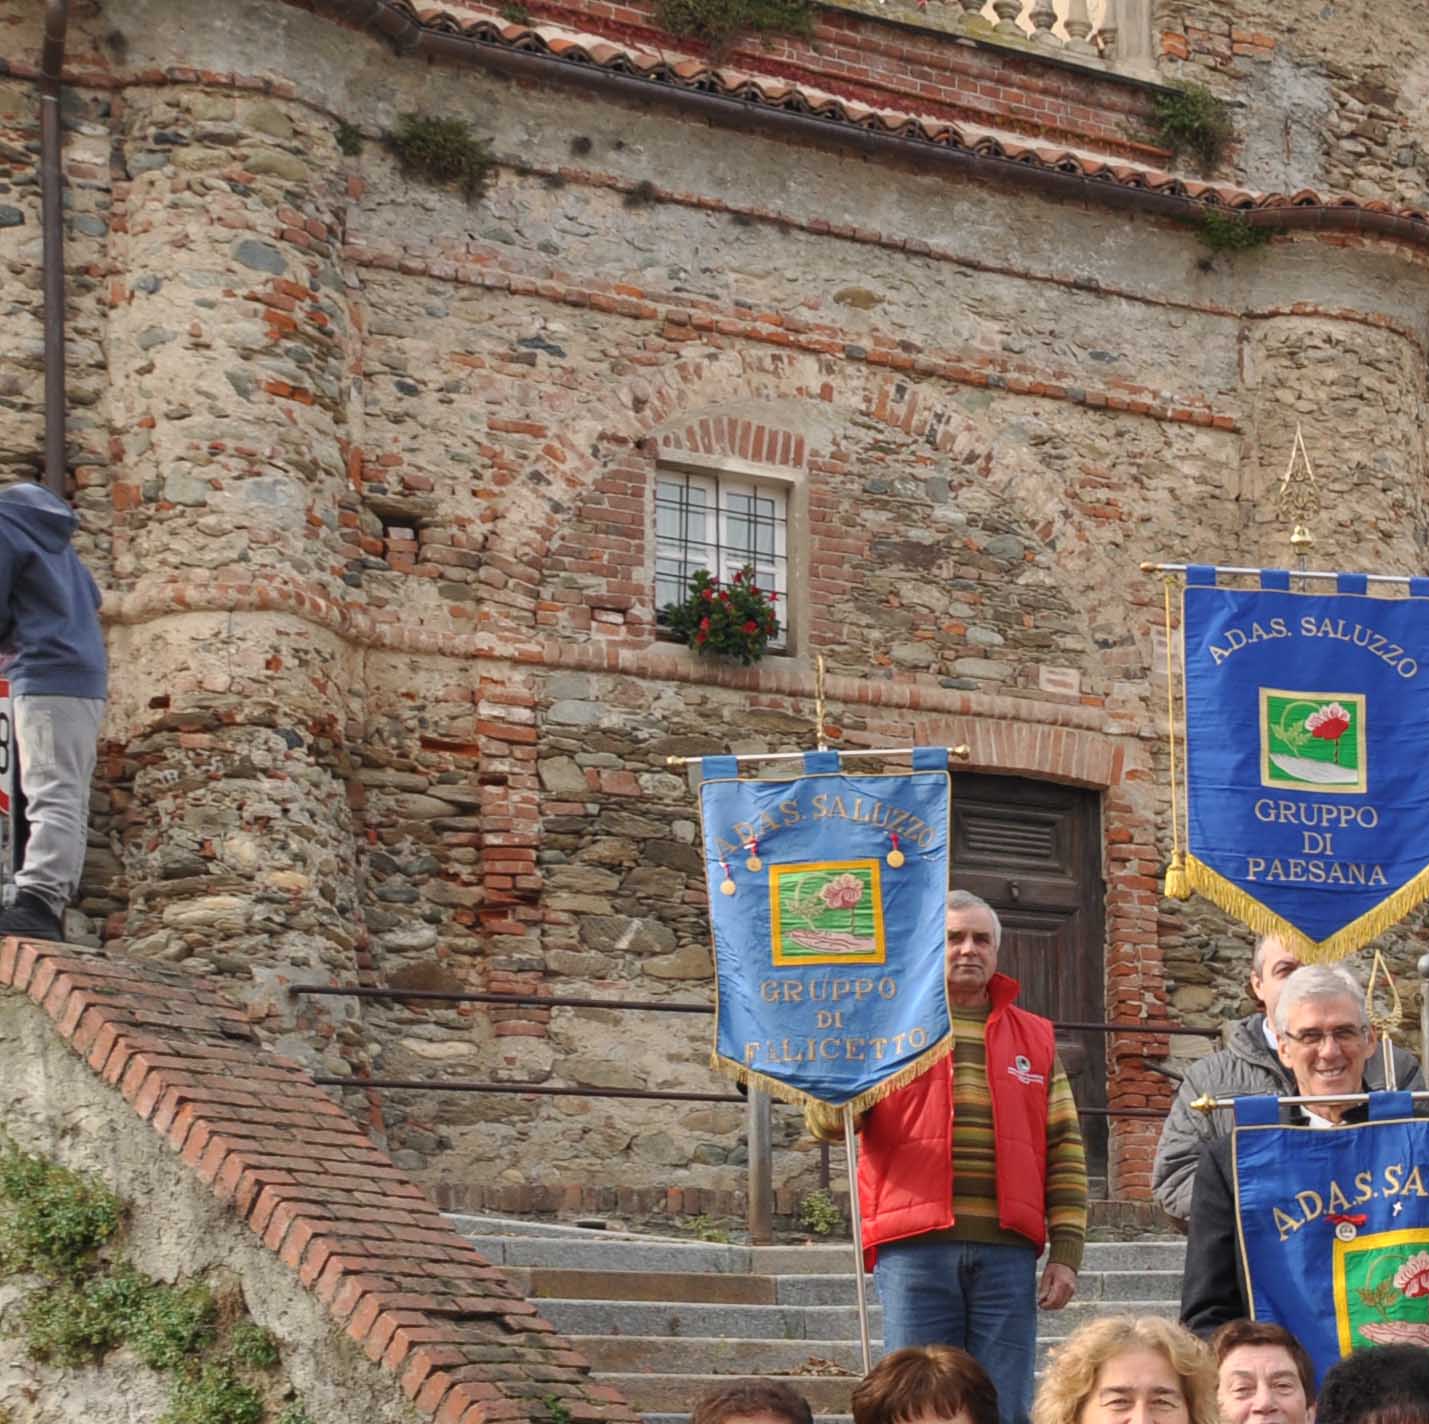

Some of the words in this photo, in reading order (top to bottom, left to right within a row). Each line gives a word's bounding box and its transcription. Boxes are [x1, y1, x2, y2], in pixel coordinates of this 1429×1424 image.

[1208, 617, 1293, 665] A.D.A.S.
[1300, 616, 1418, 678] SALUZZO
[811, 793, 936, 849] SALUZZO
[1254, 798, 1379, 829] GRUPPO
[1302, 831, 1334, 855] DI
[1246, 857, 1389, 886] PAESANA
[760, 975, 898, 1003] GRUPPO
[816, 1010, 845, 1030] DI
[1273, 1170, 1380, 1242] A.D.A.S.
